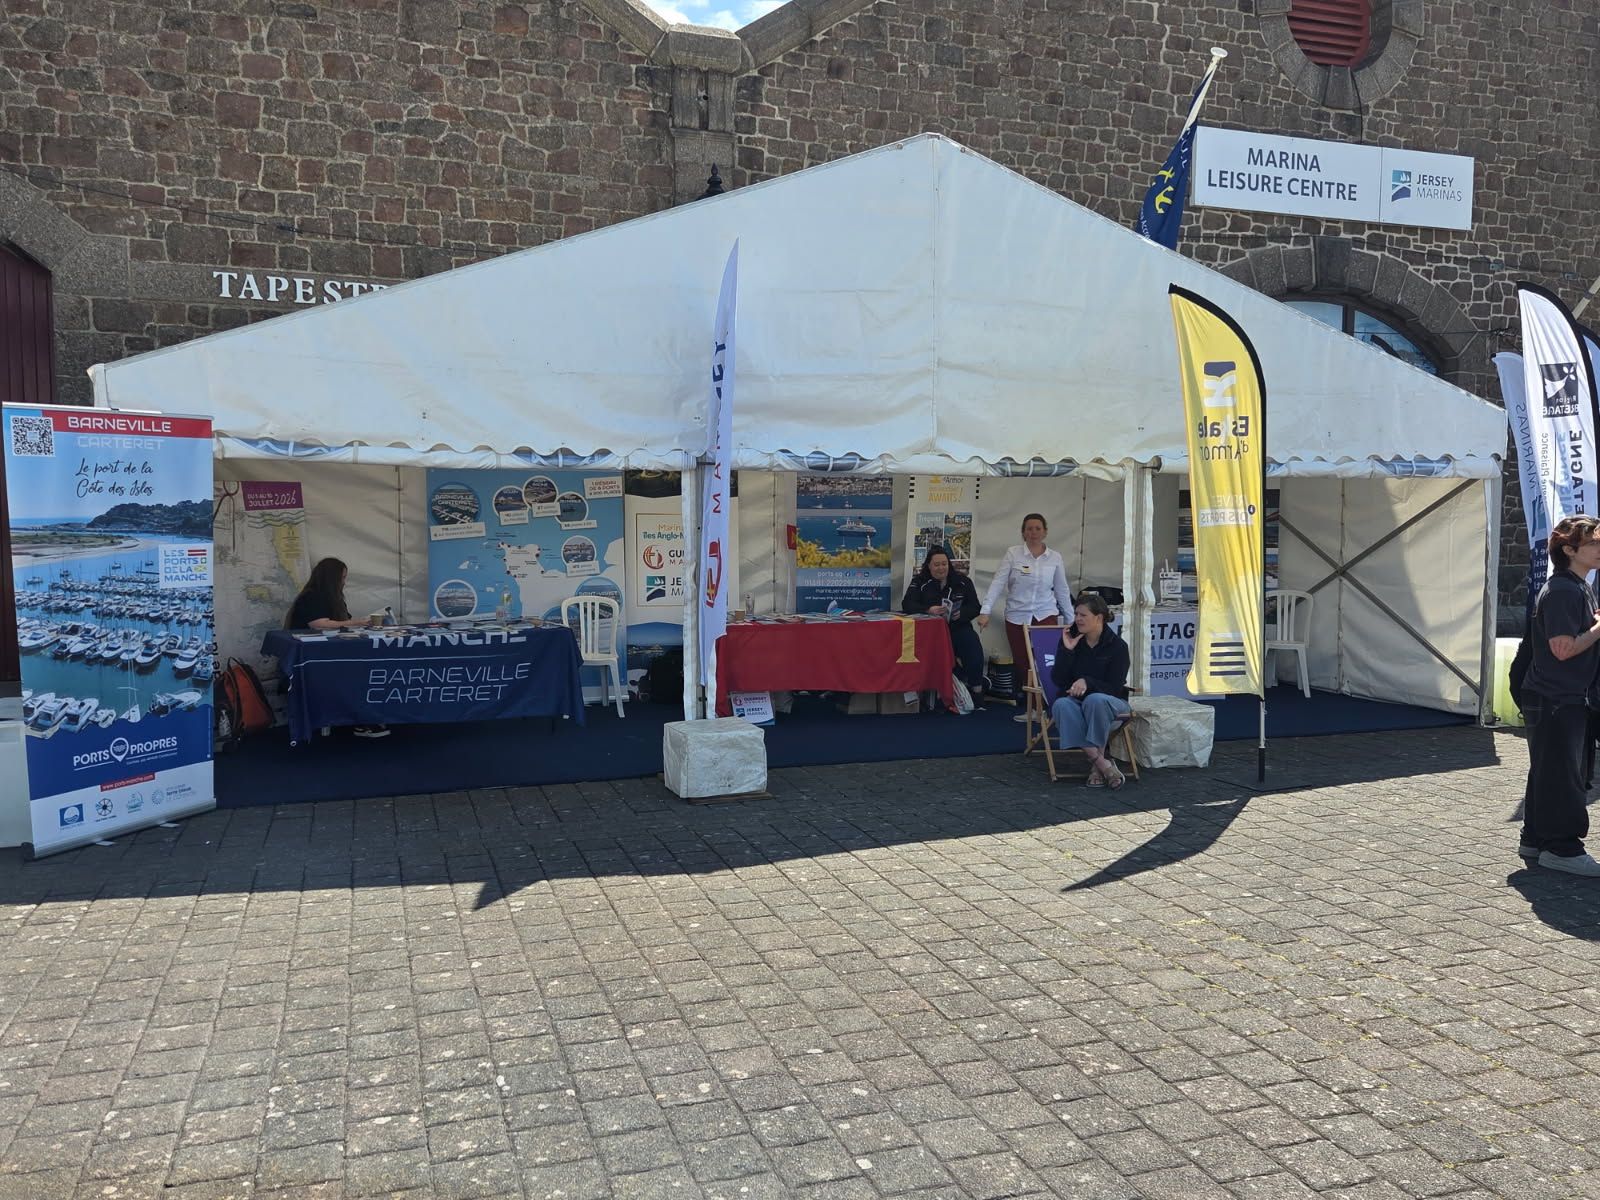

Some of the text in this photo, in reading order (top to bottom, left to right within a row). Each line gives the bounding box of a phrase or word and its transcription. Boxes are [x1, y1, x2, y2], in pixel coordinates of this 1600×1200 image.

[1247, 147, 1321, 173] MARINA
[1207, 169, 1358, 202] LEISURE CENTRE
[1416, 174, 1454, 188] JERSEY
[1416, 187, 1463, 202] MARINAS
[212, 271, 390, 305] TAPEST
[67, 416, 172, 433] BARNEVILLE
[77, 435, 165, 450] CARTERET
[75, 457, 154, 478] Le port de la
[76, 478, 105, 498] Côte
[108, 481, 126, 496] des
[274, 489, 296, 505] 2026
[658, 523, 683, 531] Marin
[164, 549, 185, 557] LES
[164, 557, 199, 565] PORTS
[164, 573, 208, 583] MANCHE
[368, 662, 532, 685] BARNEVILLE
[366, 683, 509, 703] CARTERET
[73, 749, 110, 767] PORTS
[130, 736, 178, 755] PROPRES
